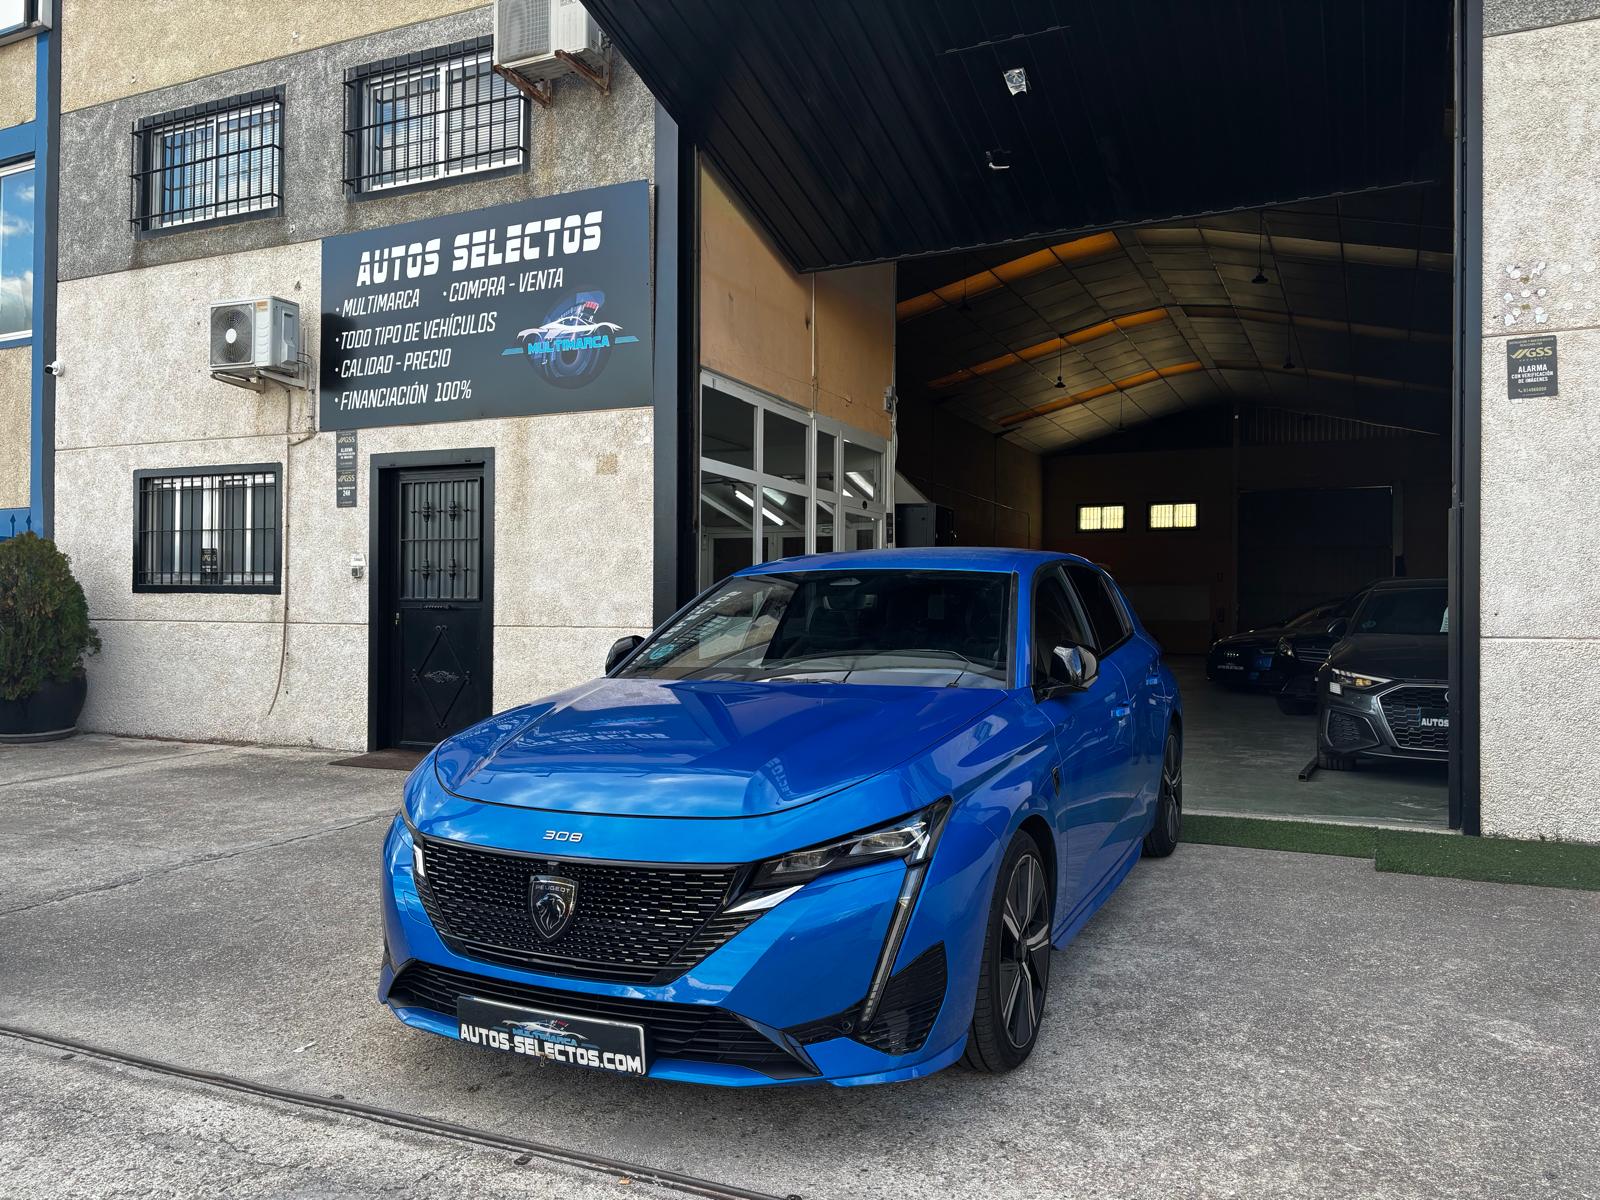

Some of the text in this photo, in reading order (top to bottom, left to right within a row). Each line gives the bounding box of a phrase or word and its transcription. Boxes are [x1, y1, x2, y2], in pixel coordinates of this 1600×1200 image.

[356, 210, 603, 287] AUTOS SELECTOS
[448, 275, 506, 303] COMPRA
[519, 267, 564, 293] VENTA
[341, 288, 420, 318] MULTIMARCA
[341, 311, 498, 350] TODO TIPO DE VEHÍCULOS
[527, 335, 610, 355] MULTIMARCA
[340, 354, 394, 379] CALIDAD
[403, 347, 452, 372] PRECIO
[1517, 364, 1548, 374] ALARMA
[340, 379, 473, 411] FINANCIACIÓN 100%
[542, 830, 583, 843] 308
[535, 884, 571, 894] PEUGEOT
[459, 1022, 643, 1075] AUTOS-SELECTOS.COM
[512, 1027, 578, 1048] MULTIMARCA
